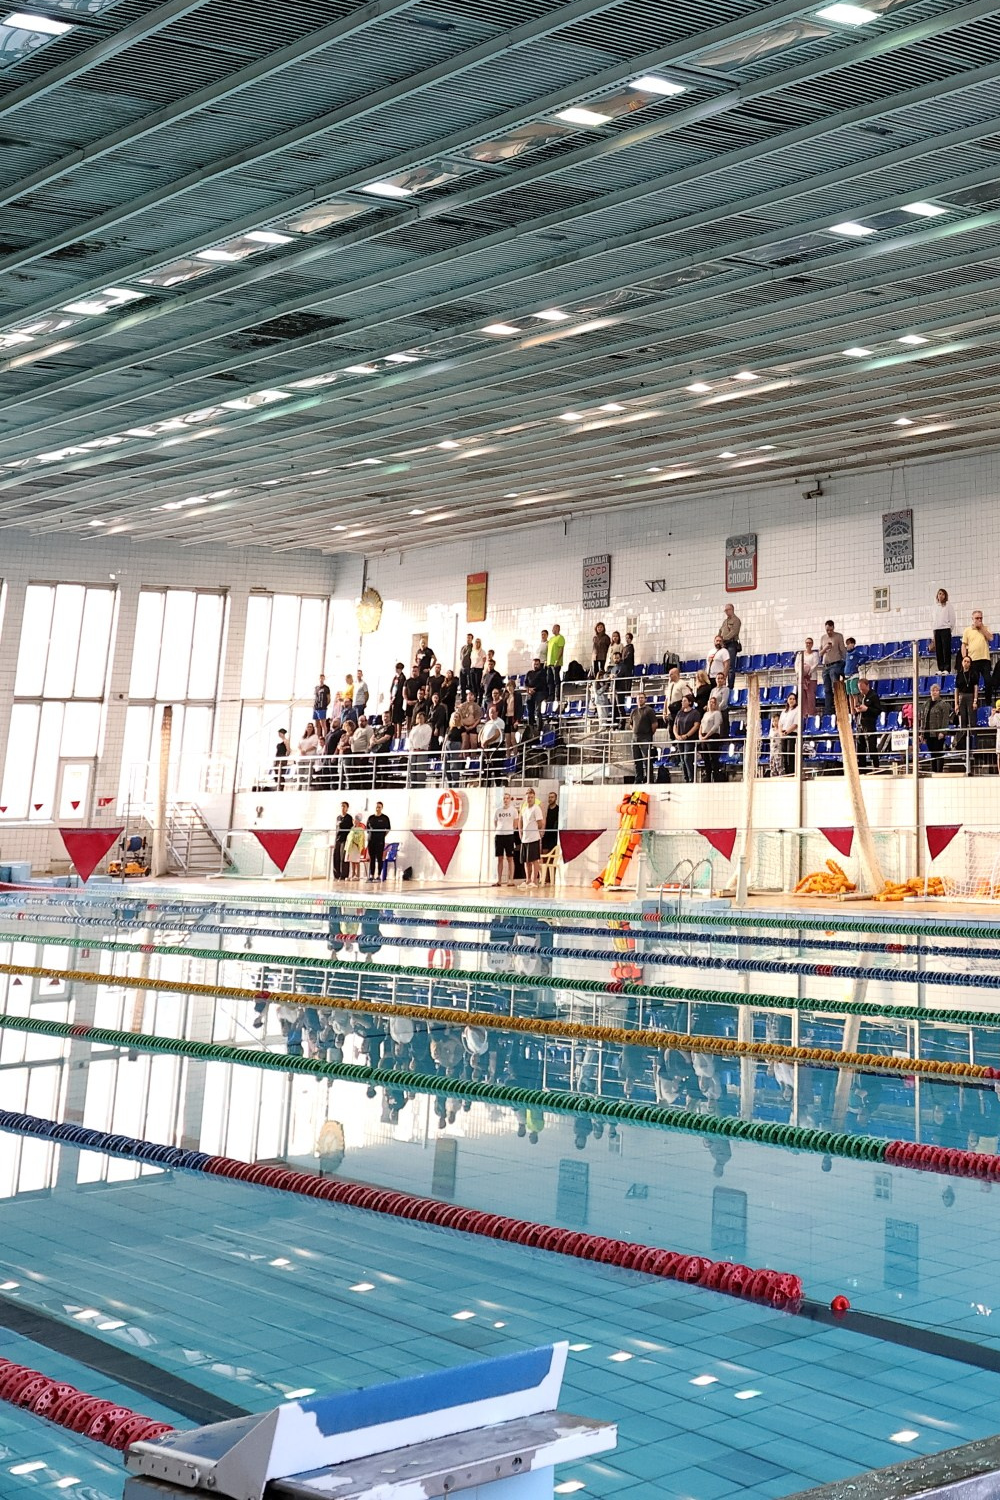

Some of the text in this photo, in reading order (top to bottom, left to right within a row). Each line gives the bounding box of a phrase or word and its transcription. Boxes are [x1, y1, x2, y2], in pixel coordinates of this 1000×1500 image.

[884, 554, 912, 566] МАСТЕР
[584, 566, 607, 577] СССР
[884, 562, 913, 573] СПОРТА
[728, 571, 753, 584] СПОРТА
